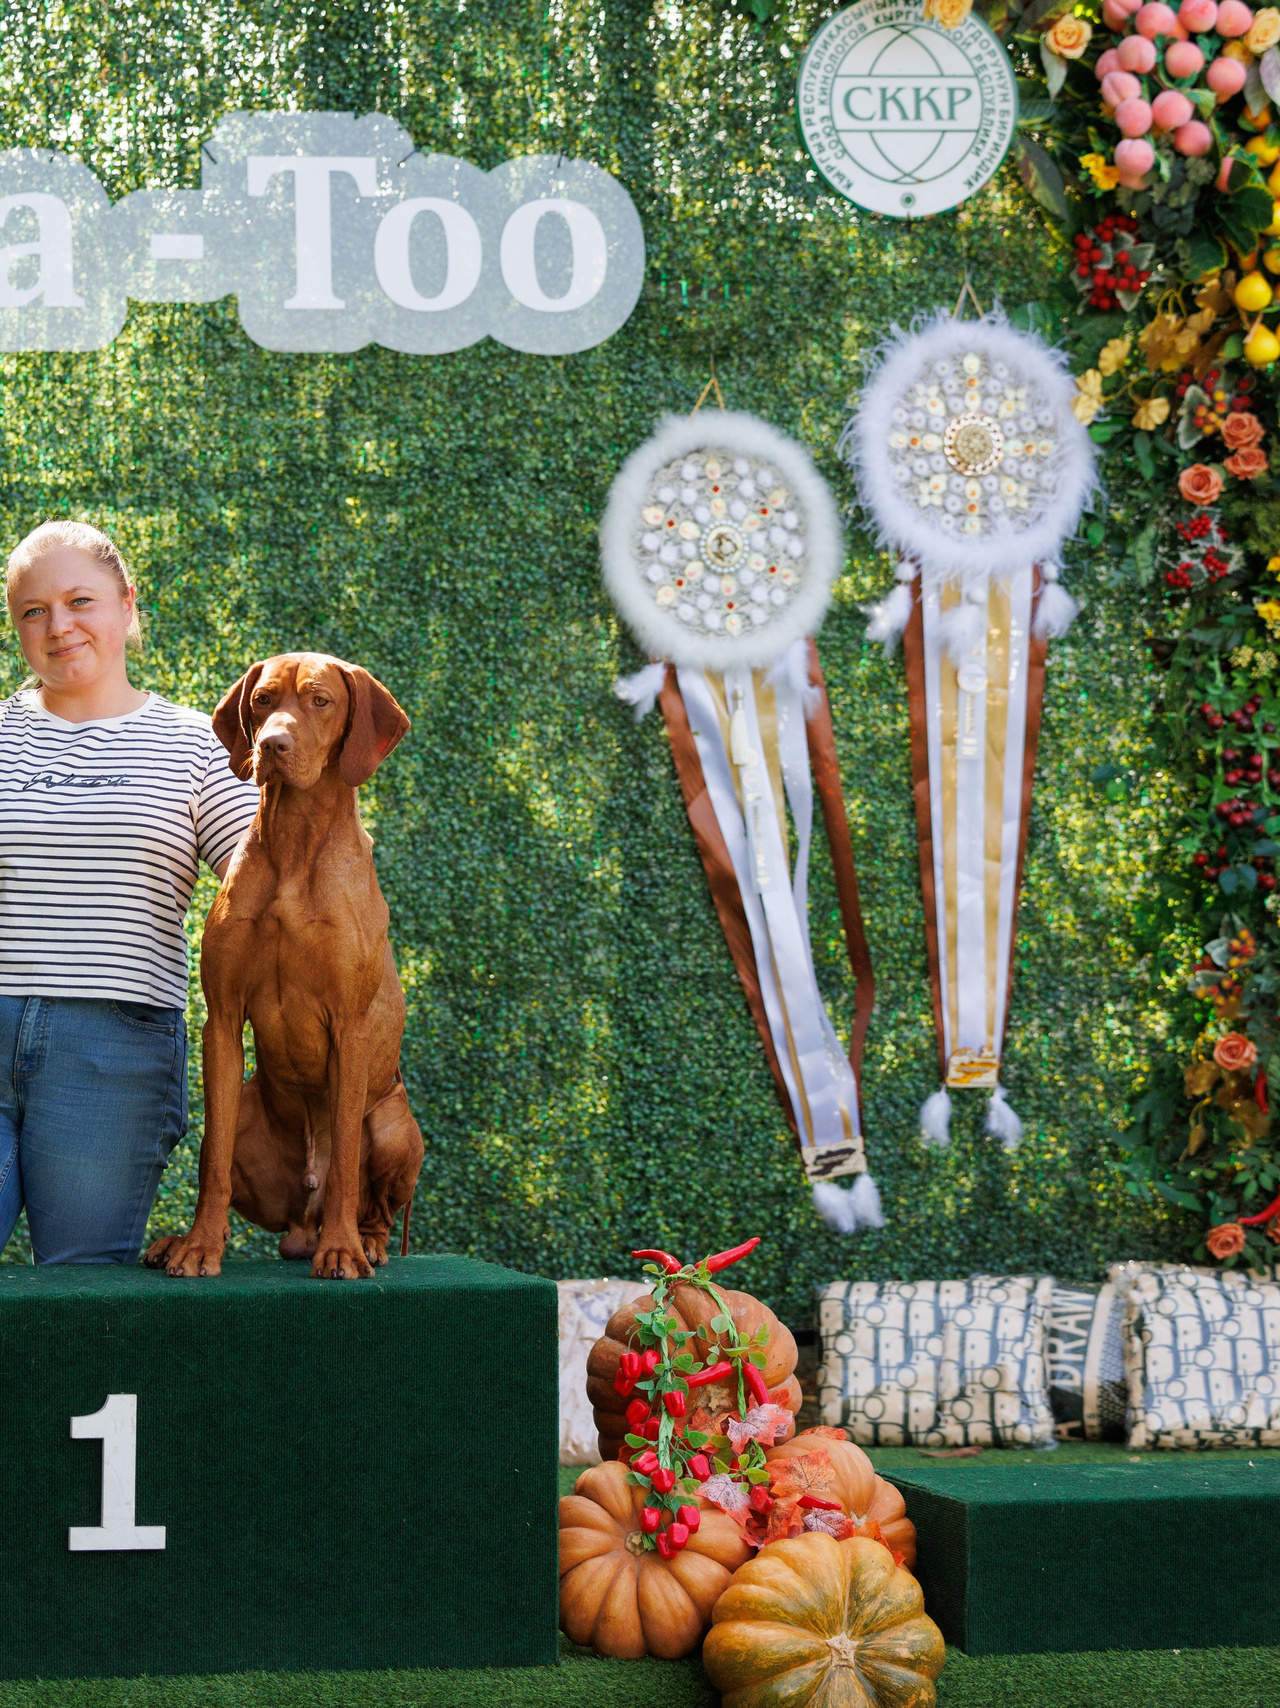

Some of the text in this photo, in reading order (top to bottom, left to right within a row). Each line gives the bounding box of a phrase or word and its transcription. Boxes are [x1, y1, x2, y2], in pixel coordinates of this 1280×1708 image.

[817, 22, 868, 106] КИНОЛОГОВ
[842, 86, 973, 122] СККР
[971, 54, 996, 158] РЕСПУБЛИКИ
[808, 132, 854, 190] КЫРГЫЗ
[819, 115, 847, 160] СОЮЗ
[246, 155, 608, 312] Тоо
[69, 1393, 167, 1551] 1
